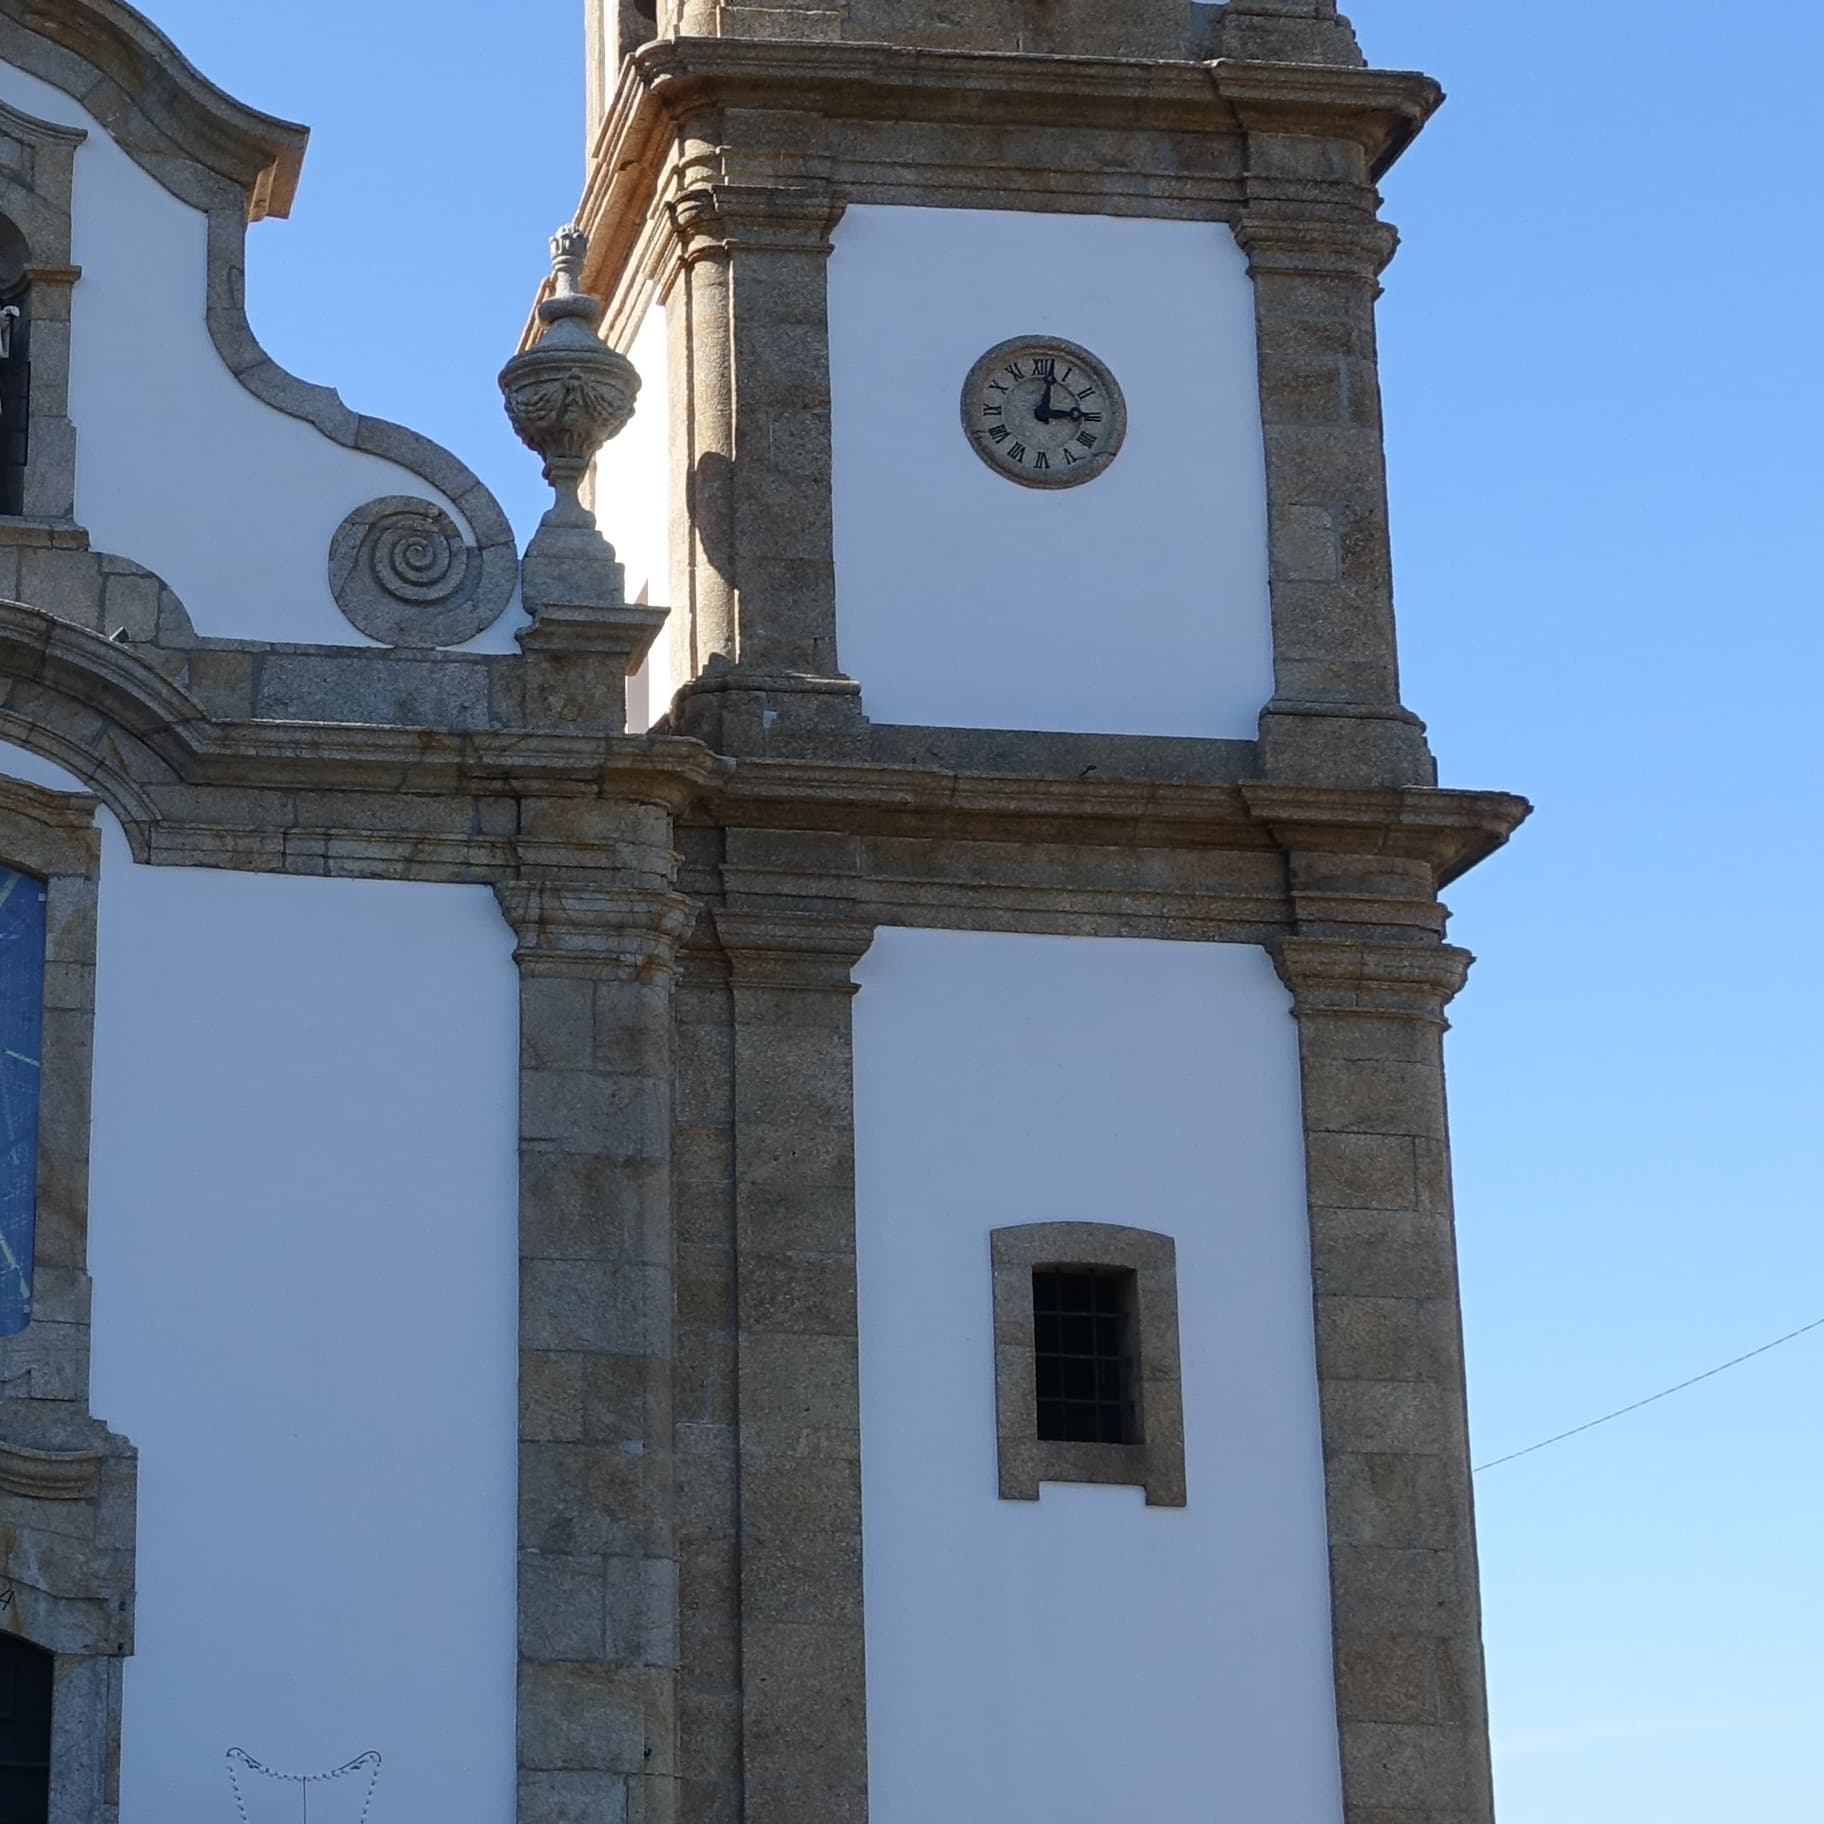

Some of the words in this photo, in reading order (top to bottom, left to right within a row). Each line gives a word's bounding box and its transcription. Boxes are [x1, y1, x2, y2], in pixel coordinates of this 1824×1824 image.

[1005, 362, 1024, 382] XI
[1061, 367, 1072, 382] I
[987, 379, 1009, 395] X
[1077, 386, 1095, 400] II
[983, 403, 1002, 417] IX
[988, 424, 1011, 444] VIII
[1007, 441, 1026, 463] VII
[1033, 451, 1051, 469] VI
[1063, 447, 1077, 465] V
